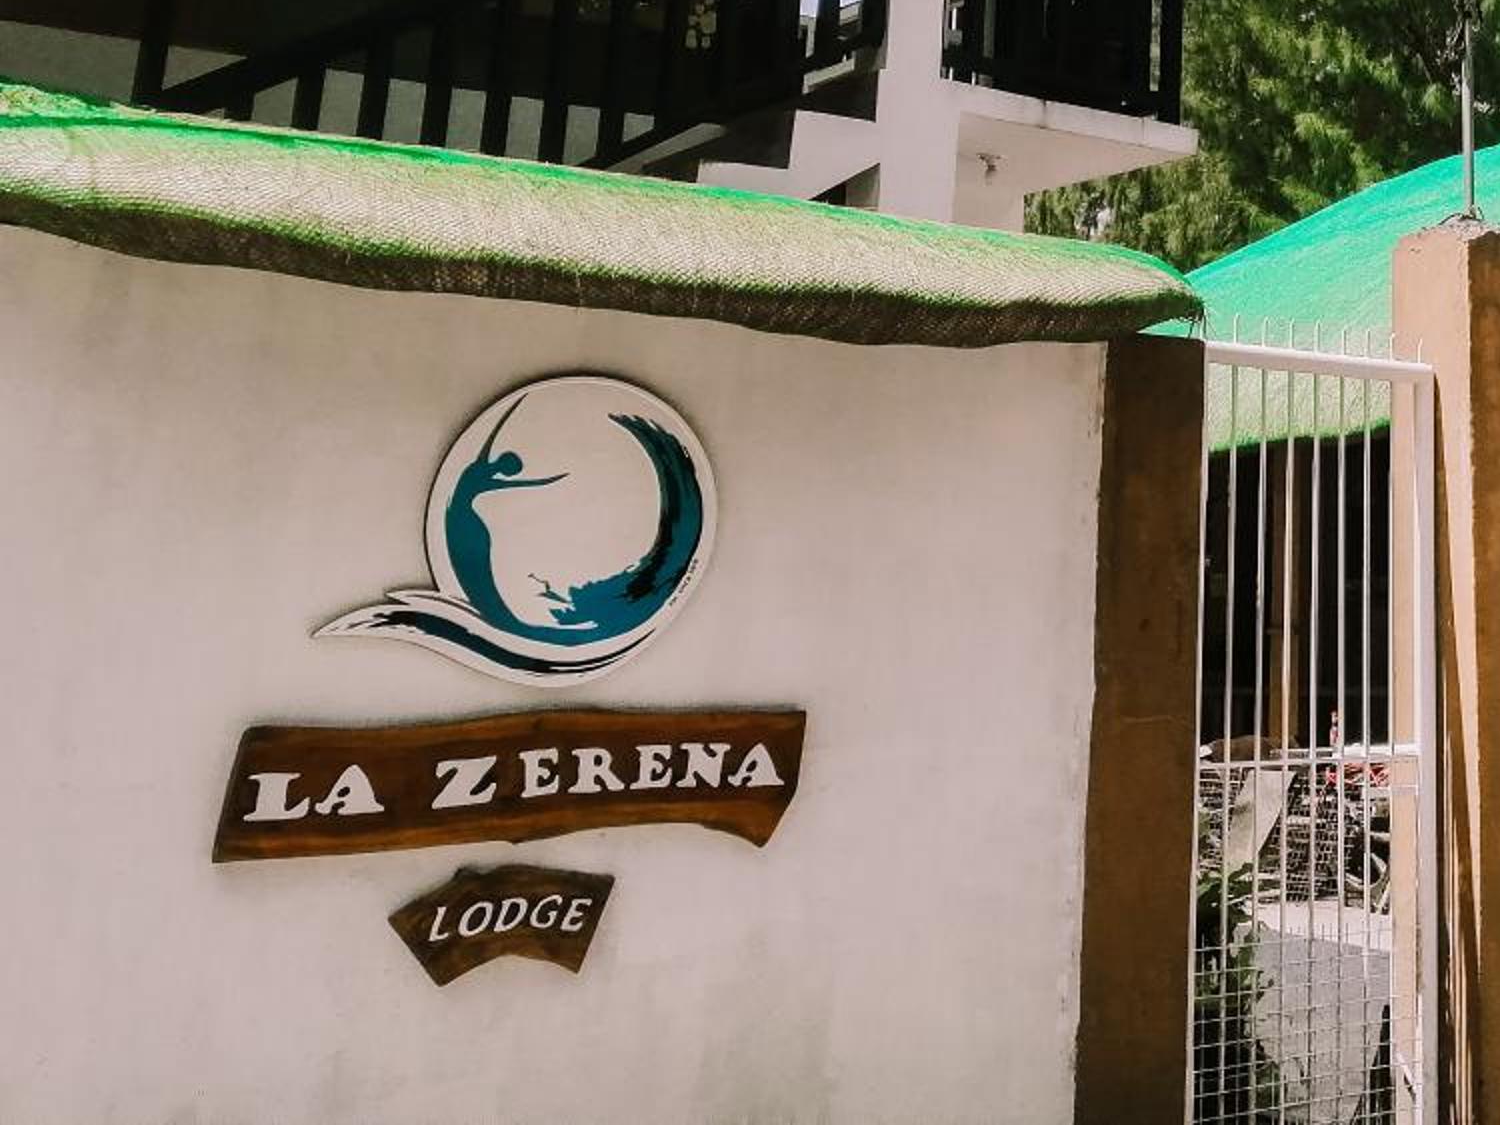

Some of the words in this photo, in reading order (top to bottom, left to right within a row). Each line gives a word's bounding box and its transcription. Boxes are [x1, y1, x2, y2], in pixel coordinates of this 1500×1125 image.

[243, 764, 385, 822] LA
[431, 742, 785, 810] ZERENA
[428, 894, 593, 942] LODGE
